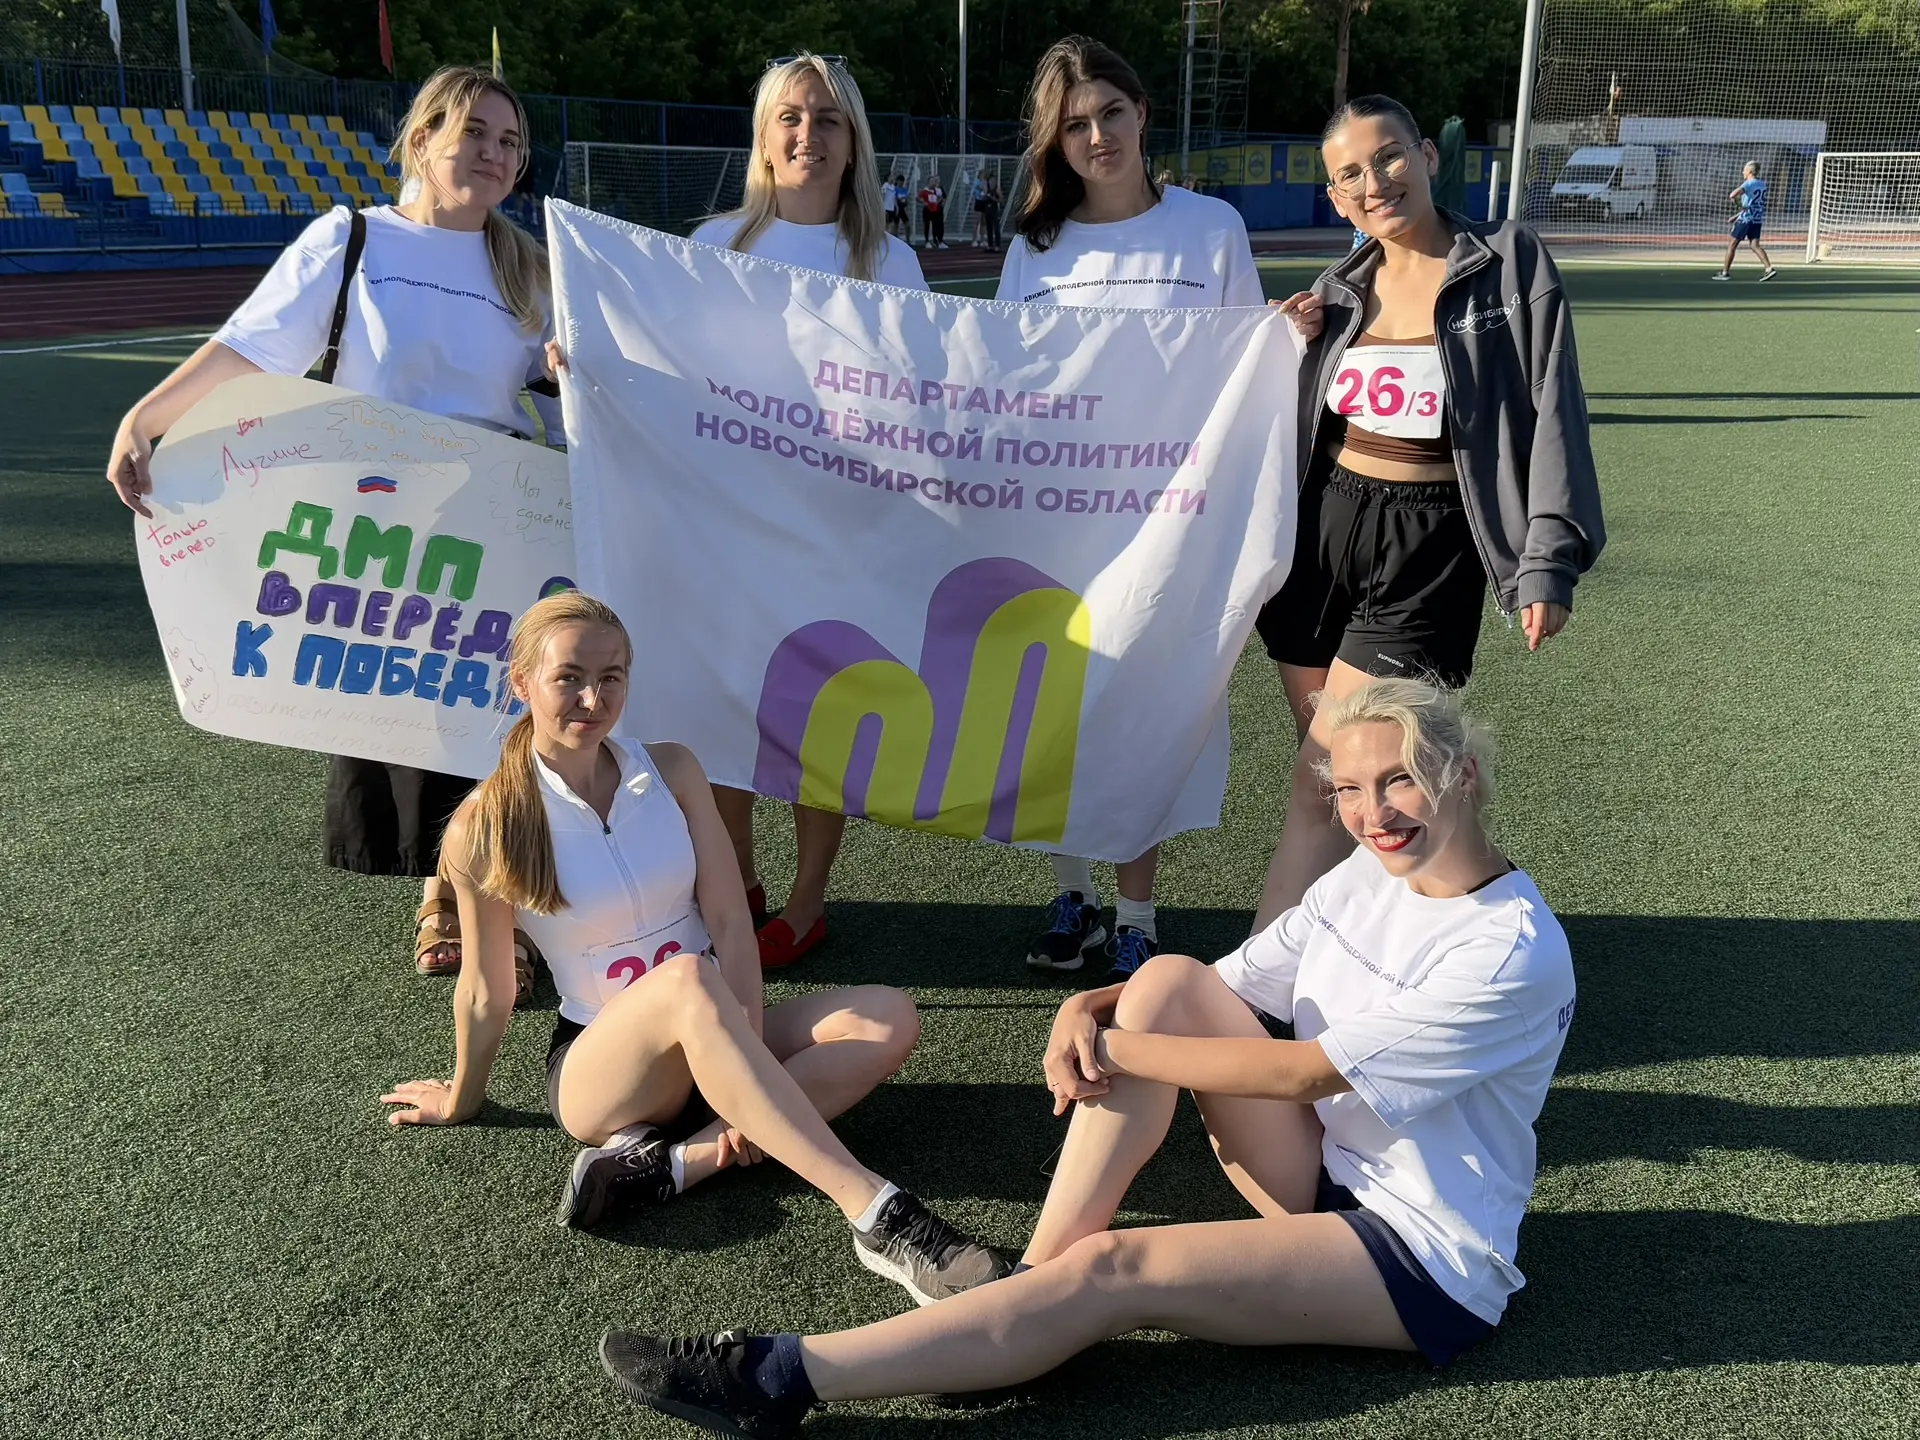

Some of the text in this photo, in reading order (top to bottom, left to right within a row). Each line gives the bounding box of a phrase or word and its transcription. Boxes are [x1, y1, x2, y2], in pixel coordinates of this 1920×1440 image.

[440, 282, 487, 302] ПОЛИТИКОЙ
[1106, 277, 1154, 286] ПОЛИТИКОЙ
[813, 359, 1103, 422] ДЕПАРТАМЕНТ
[1336, 367, 1437, 416] 26/3
[705, 376, 1201, 469] МОЛОДЁЖНОЙ ПОЛИТИКИ
[696, 411, 1207, 515] НОВОСИБИРСКОЙ ОБЛАСТИ
[516, 508, 572, 530] сдаёмс
[256, 500, 486, 601] ДМП
[256, 570, 513, 662] ВПЕРЁД
[231, 620, 273, 677] К
